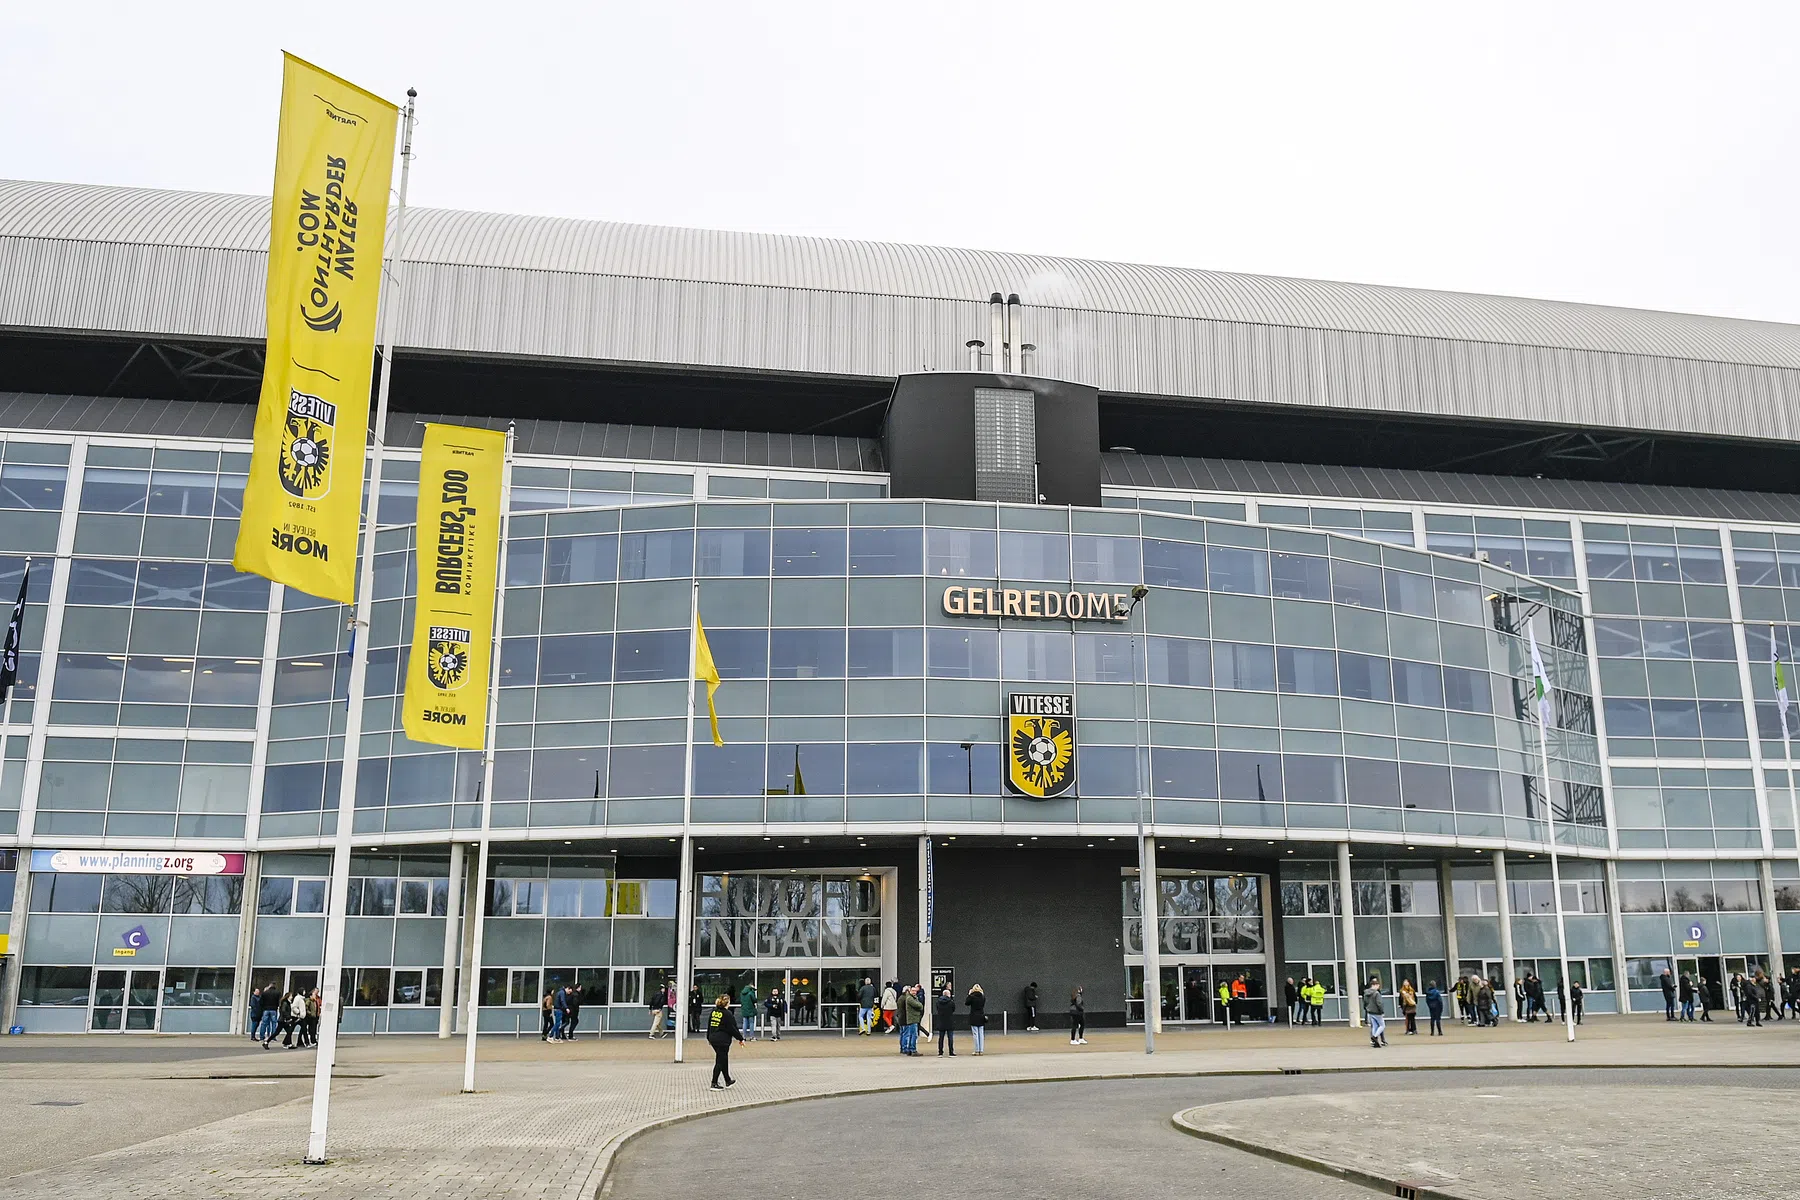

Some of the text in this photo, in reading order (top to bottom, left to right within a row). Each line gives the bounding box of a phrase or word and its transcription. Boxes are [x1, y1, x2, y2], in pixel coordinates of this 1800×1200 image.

[943, 585, 1129, 620] GELREDOME
[1013, 695, 1070, 714] VITESSE
[79, 853, 194, 871] www.planningz.org
[697, 875, 881, 917] HOOFD
[129, 931, 142, 947] C
[694, 918, 880, 957] INGANG
[1691, 926, 1702, 940] D
